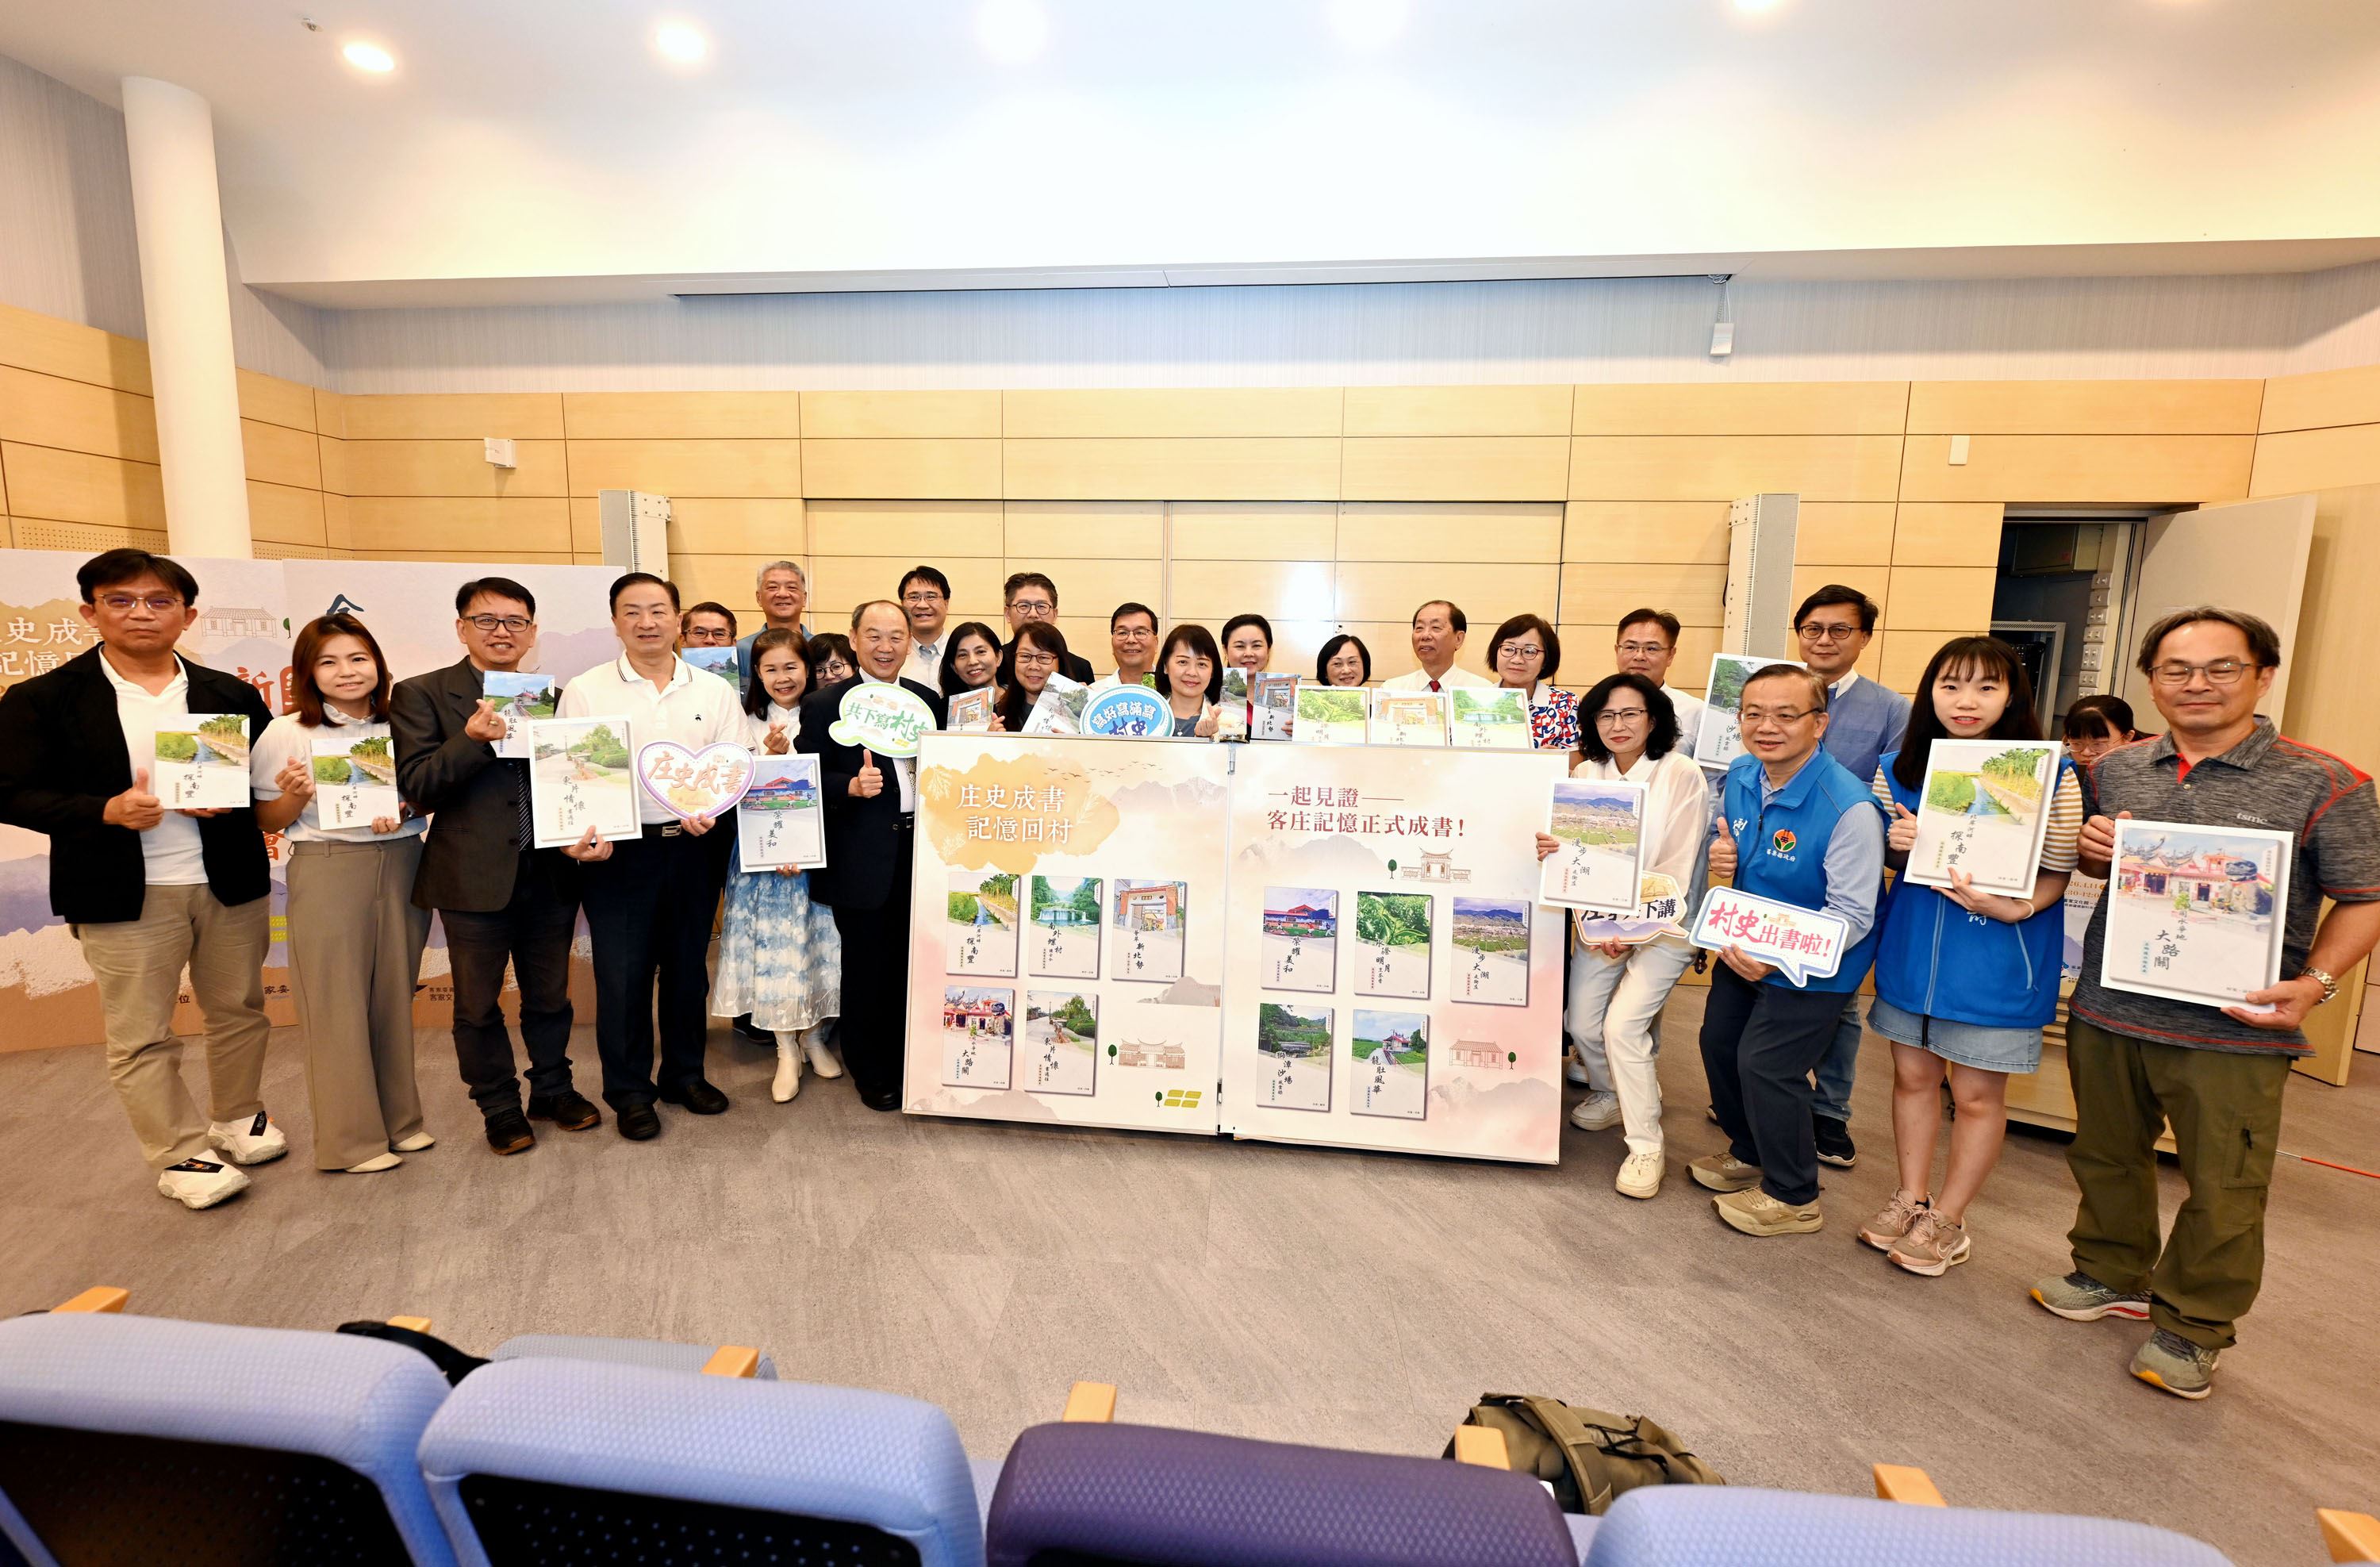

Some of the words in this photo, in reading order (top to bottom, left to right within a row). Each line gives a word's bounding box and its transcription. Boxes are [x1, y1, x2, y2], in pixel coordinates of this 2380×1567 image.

[0, 616, 105, 646] 史成
[0, 650, 84, 677] 記憶
[647, 751, 746, 794] 庄史成書
[956, 783, 1066, 813] 庄史成書
[965, 816, 1073, 845] 記憶回村
[2236, 812, 2268, 825] tsmc
